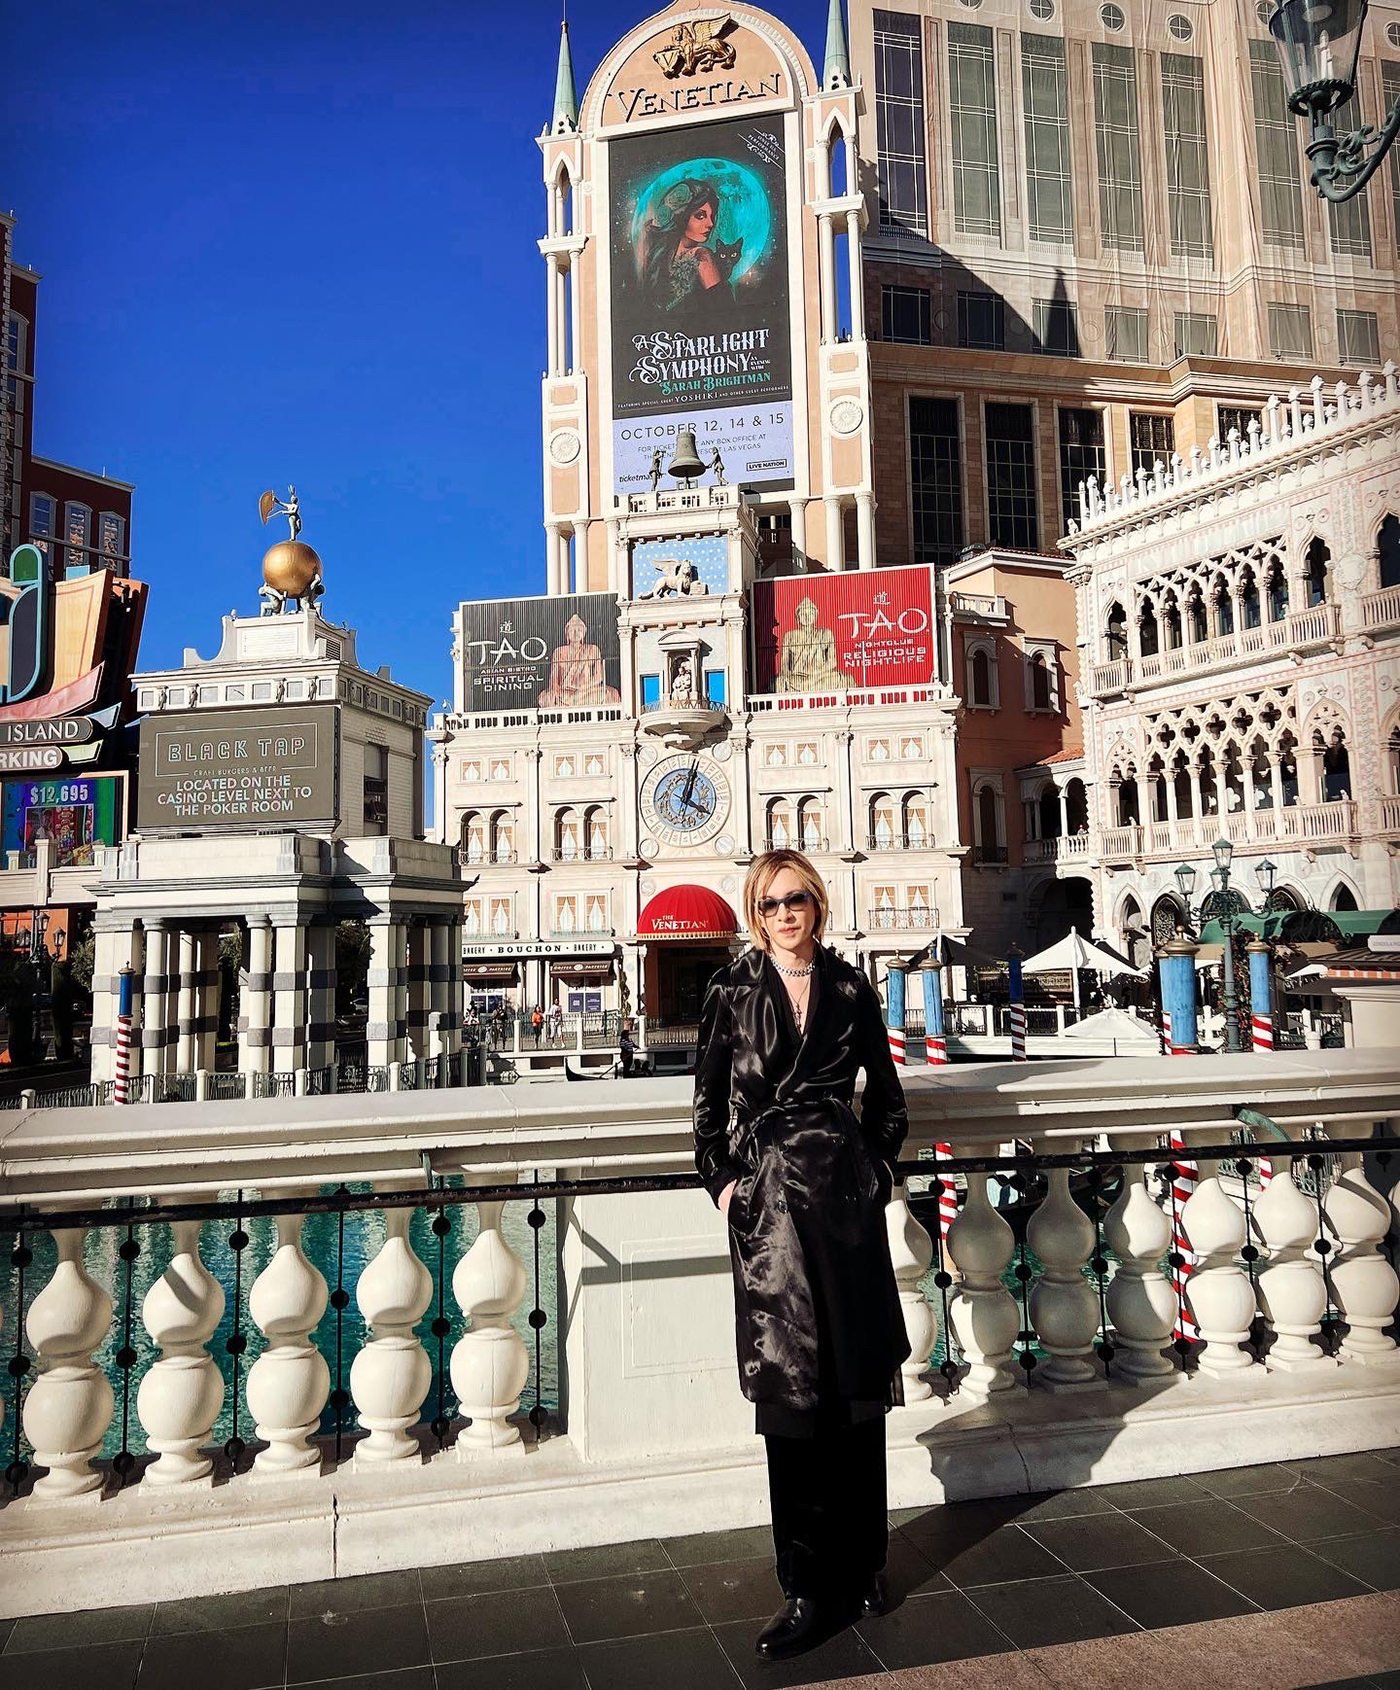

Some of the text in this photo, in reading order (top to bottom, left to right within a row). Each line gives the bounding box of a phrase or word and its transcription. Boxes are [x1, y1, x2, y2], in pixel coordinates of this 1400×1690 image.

[611, 73, 781, 122] VENETIAN
[632, 328, 770, 359] A STARLIGHT
[629, 352, 751, 384] SYMPHONY
[660, 372, 771, 396] SARAH BRIGHTMAN
[675, 392, 718, 403] YOSHIKI
[620, 412, 784, 440] OCTOBER 12, 14 & 15
[654, 443, 678, 451] TICKET
[732, 434, 758, 443] OFFICE
[738, 443, 762, 451] VEGAS
[762, 460, 785, 468] NATION
[838, 608, 930, 640] TAO
[467, 636, 549, 666] TAO
[844, 646, 926, 660] RELIGIOUS
[480, 665, 537, 675] ASIAN BISTRO
[844, 655, 925, 668] NIGHTLIFE
[474, 675, 544, 686] SPIRITUAL
[484, 682, 532, 692] DINING
[7, 721, 79, 742] ISLAND
[168, 737, 305, 762] BLACK TAP
[218, 768, 250, 776] BURGERS
[176, 774, 292, 792] LOCATED ON THE
[30, 784, 88, 805] $12,695
[158, 786, 312, 805] CASINO LEVEL NEXT TO
[174, 800, 294, 816] THE POKER ROOM
[651, 918, 707, 931] VENETIAN
[498, 944, 562, 954] BOUCHON
[574, 944, 597, 952] BAKERY
